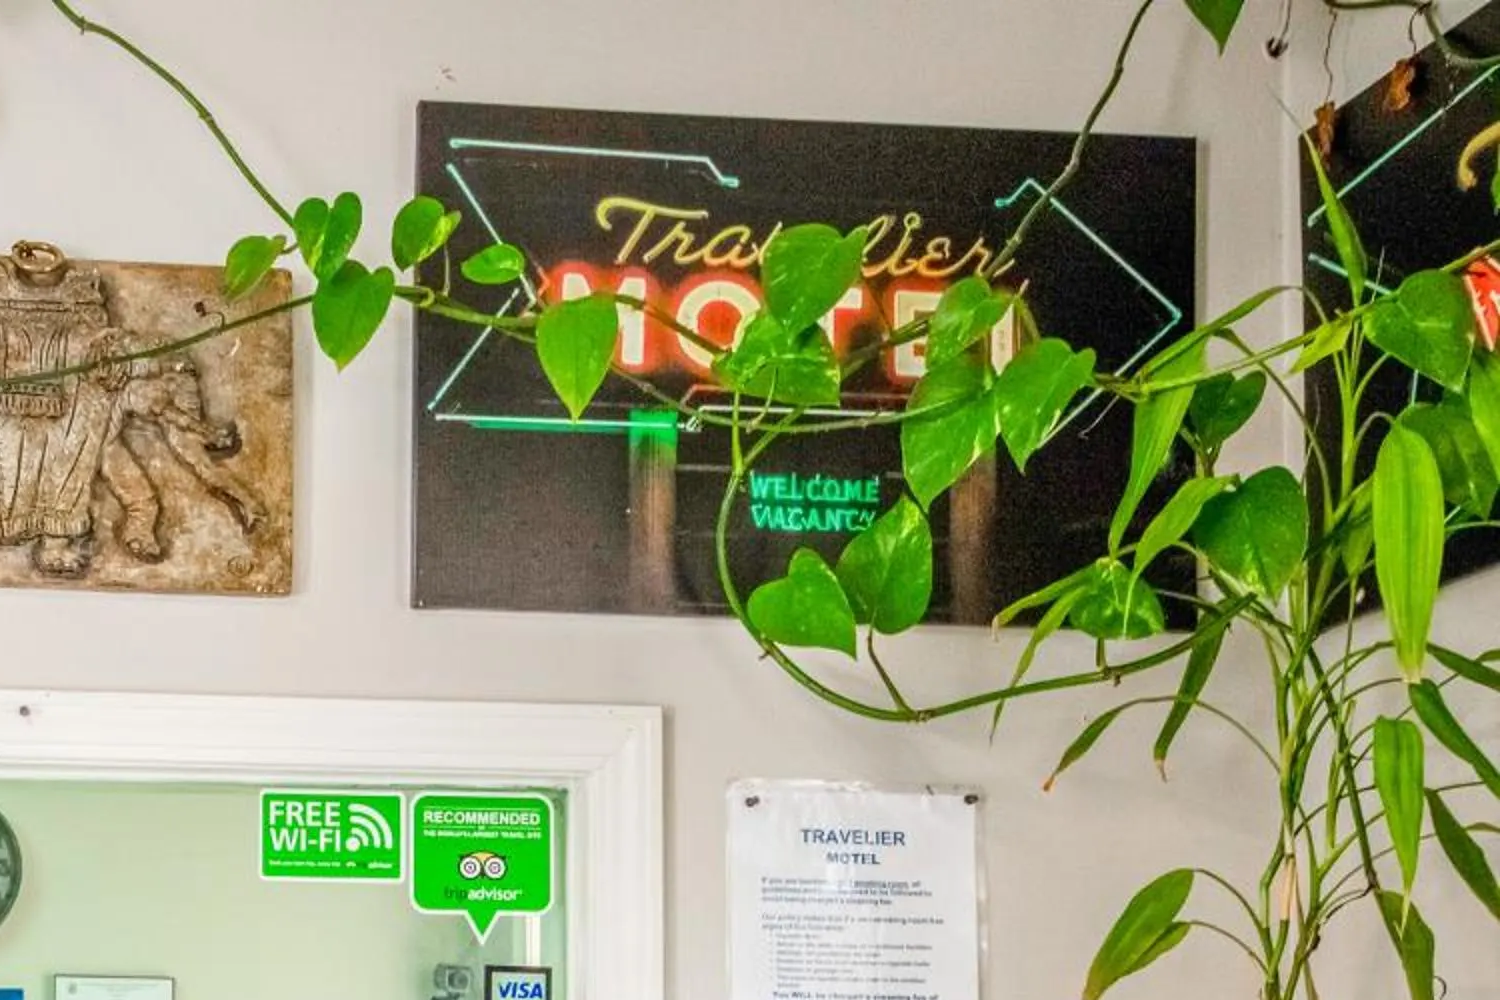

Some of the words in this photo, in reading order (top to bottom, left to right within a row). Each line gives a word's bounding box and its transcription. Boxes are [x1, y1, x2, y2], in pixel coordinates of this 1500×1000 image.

[596, 197, 1015, 279] Tralier
[750, 471, 879, 502] WELCOME
[751, 503, 877, 531] VACANCY
[269, 801, 341, 827] FREE
[423, 811, 541, 825] RECOMMENDED
[269, 827, 341, 853] WI-FI
[800, 828, 906, 847] TRAVELIER
[826, 851, 881, 866] MOTEL
[445, 886, 518, 901] tripadvisor
[498, 982, 543, 999] VISA
